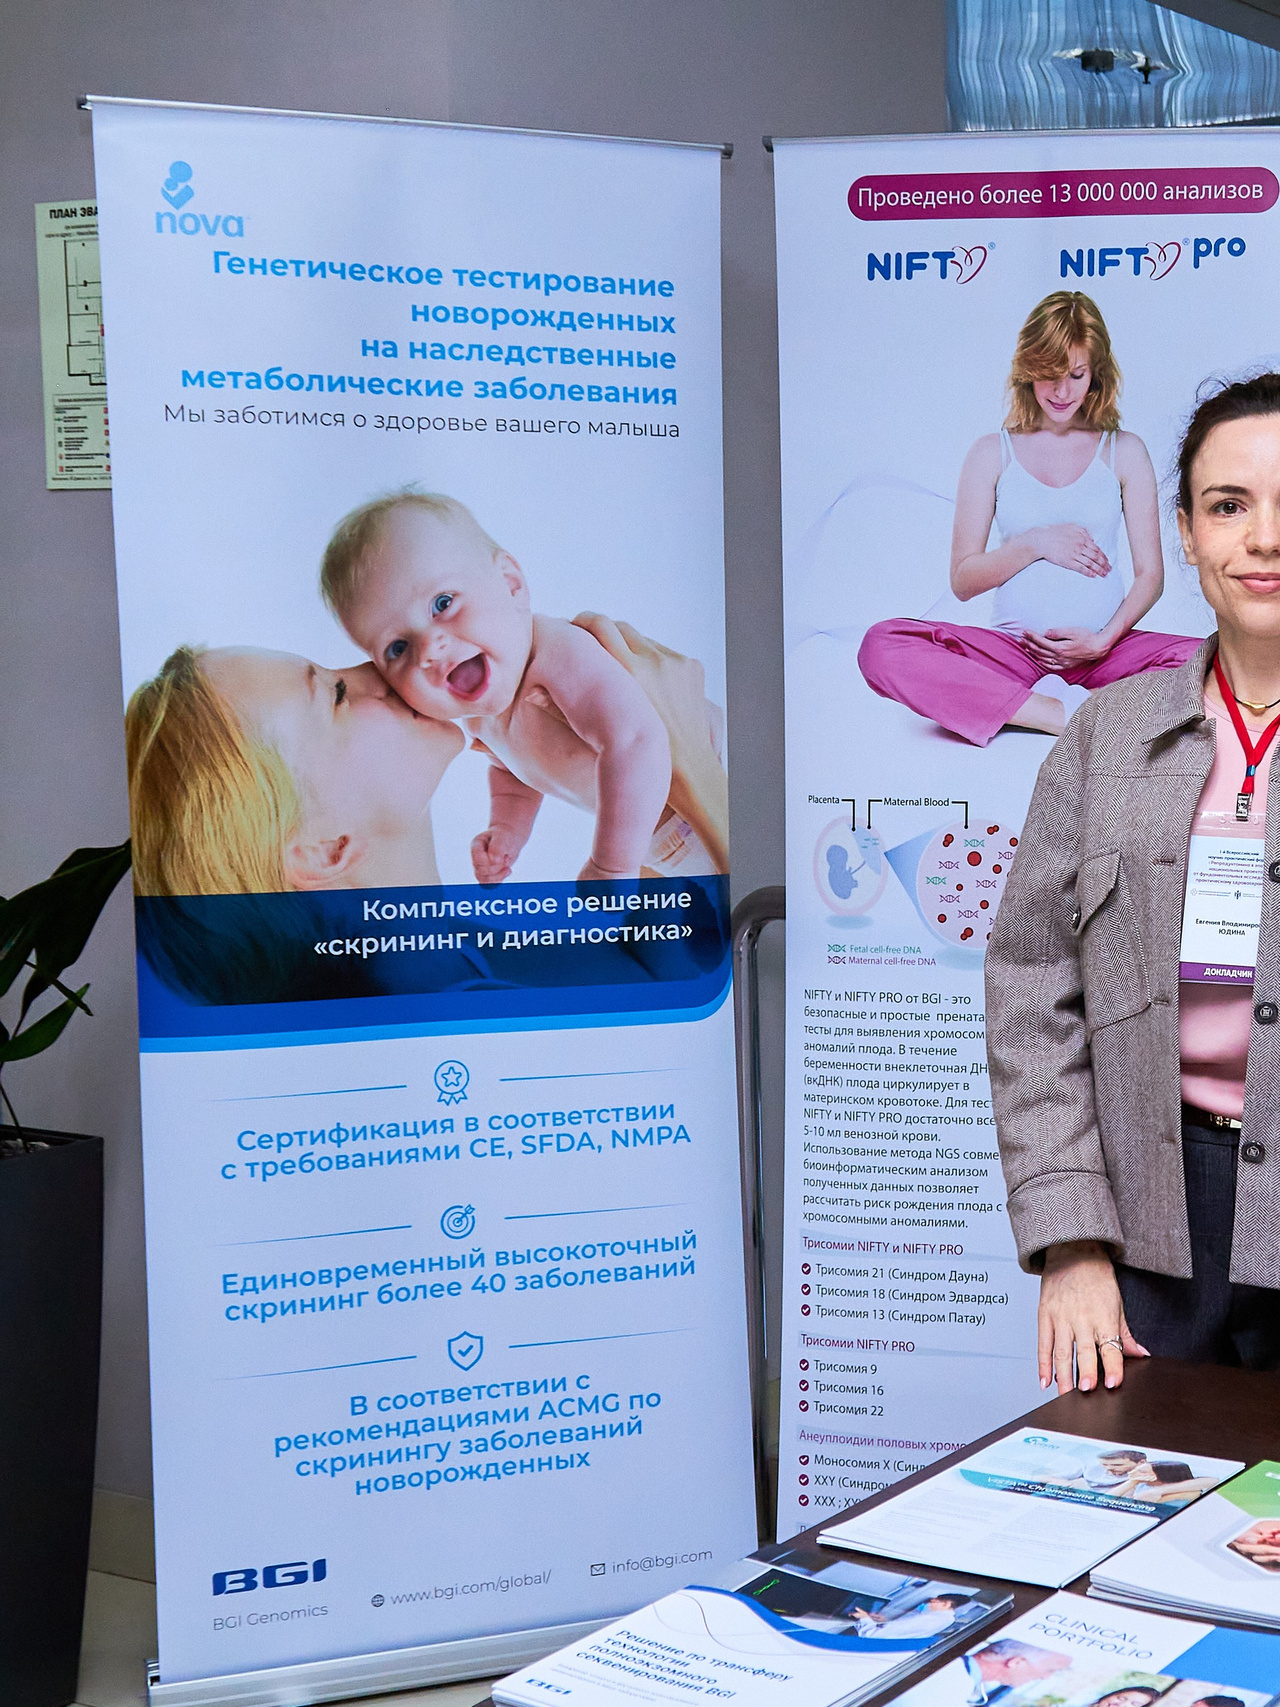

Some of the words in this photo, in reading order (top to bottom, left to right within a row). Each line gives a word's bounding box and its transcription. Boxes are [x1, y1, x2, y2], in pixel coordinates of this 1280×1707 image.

[858, 184, 975, 211] Проведено
[979, 185, 1043, 205] более
[1048, 184, 1071, 203] 13
[1076, 182, 1114, 203] 000
[1120, 182, 1158, 203] 000
[1162, 182, 1264, 201] анализов
[49, 208, 77, 219] ПЛАН
[154, 208, 245, 238] nova
[1192, 236, 1247, 269] pro
[213, 250, 444, 287] Генетическое
[452, 265, 675, 299] тестирование
[410, 300, 676, 334] новорожденных
[360, 335, 399, 359] на
[409, 338, 677, 371] наследственные
[181, 367, 463, 399] метаболические
[473, 378, 678, 407] заболевания
[163, 404, 206, 424] Мы
[213, 404, 346, 429] заботимся
[353, 413, 368, 429] о
[374, 413, 488, 436] здоровье
[495, 415, 581, 437] вашего
[587, 420, 680, 440] малыша
[808, 795, 840, 804] Placenta
[884, 798, 922, 806] Maternal
[924, 798, 949, 807] Blood
[363, 894, 558, 921] Комплексное
[566, 889, 692, 917] решение
[314, 929, 469, 958] «скрининг
[477, 931, 495, 947] и
[502, 921, 693, 950] диагностика»
[850, 945, 868, 953] Fetal
[870, 945, 901, 954] cell-free
[903, 946, 921, 954] DNA
[848, 956, 882, 965] Maternal
[884, 957, 916, 966] cell-free
[917, 957, 936, 966] DNA
[804, 989, 832, 1001] NIFTY
[835, 993, 842, 1001] и
[844, 991, 876, 1003] NIFTY
[879, 993, 903, 1004] PRO
[906, 995, 919, 1004] от
[922, 993, 941, 1004] BGI
[951, 995, 971, 1004] это
[804, 1006, 867, 1020] безопасные
[870, 1012, 877, 1020] и
[880, 1011, 930, 1021] простые
[936, 1013, 985, 1024] прената
[804, 1025, 832, 1035] тесты
[834, 1027, 853, 1037] для
[856, 1028, 921, 1038] выявления
[924, 1030, 984, 1041] хромосом
[804, 1042, 856, 1053] аномалий
[858, 1046, 896, 1056] плода.
[899, 1045, 906, 1054] В
[909, 1047, 957, 1056] течение
[804, 1075, 843, 1087] (вкДНК)
[846, 1079, 879, 1089] плода
[883, 1081, 959, 1091] циркулирует
[963, 1082, 970, 1090] в
[804, 1093, 874, 1105] материнском
[877, 1098, 942, 1108] кровотоке.
[945, 1097, 968, 1109] Для
[237, 1116, 456, 1154] Сертификация
[464, 1113, 479, 1133] в
[487, 1103, 675, 1132] соответствии
[804, 1126, 825, 1137] 5-10
[827, 1129, 841, 1138] мл
[844, 1130, 898, 1141] венозной
[902, 1132, 941, 1142] крови.
[220, 1161, 238, 1180] с
[245, 1141, 460, 1181] требованиями
[469, 1138, 514, 1161] CE,
[520, 1131, 604, 1154] SFDA,
[611, 1124, 692, 1148] NMPA
[804, 1159, 927, 1176] биоинформатическим
[930, 1168, 988, 1177] анализом
[804, 1177, 868, 1192] полученных
[871, 1182, 914, 1193] данных
[917, 1184, 979, 1194] позволяет
[803, 1194, 861, 1208] рассчитать
[864, 1199, 891, 1210] риск
[894, 1201, 954, 1211] рождения
[957, 1202, 992, 1212] плода
[996, 1204, 1002, 1212] с
[802, 1211, 888, 1226] хромосомными
[891, 1218, 968, 1228] аномалиями.
[803, 1237, 855, 1252] Трисомии
[858, 1241, 890, 1253] NIFTY
[893, 1244, 899, 1253] и
[903, 1244, 936, 1255] NIFTY
[939, 1244, 964, 1256] PRO
[221, 1250, 486, 1297] Единовременный
[494, 1231, 698, 1267] высокоточный
[816, 1264, 869, 1278] Трисомия
[872, 1268, 884, 1278] 21
[888, 1269, 946, 1282] (Синдром
[949, 1271, 989, 1284] Дауна)
[224, 1289, 370, 1323] скрининг
[377, 1276, 463, 1305] более
[471, 1273, 506, 1294] 40
[513, 1257, 696, 1291] заболеваний
[816, 1284, 869, 1298] Трисомия
[873, 1289, 885, 1299] 18
[888, 1289, 946, 1303] (Синдром
[949, 1291, 1009, 1305] Эдвардса)
[816, 1305, 869, 1319] Трисомия
[873, 1310, 885, 1320] 13
[888, 1310, 946, 1324] (Синдром
[949, 1312, 986, 1326] Патау)
[801, 1334, 854, 1349] Трисомии
[856, 1339, 888, 1350] NIFTY
[892, 1341, 915, 1352] PRO
[814, 1360, 867, 1374] Трисомия
[871, 1365, 878, 1375] 9
[349, 1395, 368, 1417] В
[376, 1377, 569, 1412] соответствии
[576, 1371, 591, 1390] с
[274, 1408, 530, 1457] рекомендациями
[538, 1393, 620, 1420] ACMG
[628, 1390, 661, 1411] по
[296, 1441, 451, 1477] скринингу
[459, 1416, 644, 1454] заболеваний
[355, 1451, 591, 1496] новорожденных
[611, 1549, 714, 1574] info@bgi.com
[212, 1558, 327, 1598] BGI
[390, 1569, 552, 1606] www.bgi.com/global/
[213, 1614, 242, 1632] BGI
[247, 1603, 329, 1627] Genomics
[1044, 1612, 1139, 1645] CLINICAL
[604, 1639, 690, 1667] технологии
[1027, 1622, 1153, 1660] PORTFOLIO
[589, 1645, 717, 1685] полноэкзомного
[616, 1630, 684, 1655] Решение
[686, 1653, 706, 1662] по
[709, 1659, 793, 1682] трансферу
[526, 1679, 572, 1695] BGI
[576, 1652, 703, 1691] секвенирования
[705, 1687, 736, 1699] BGI
